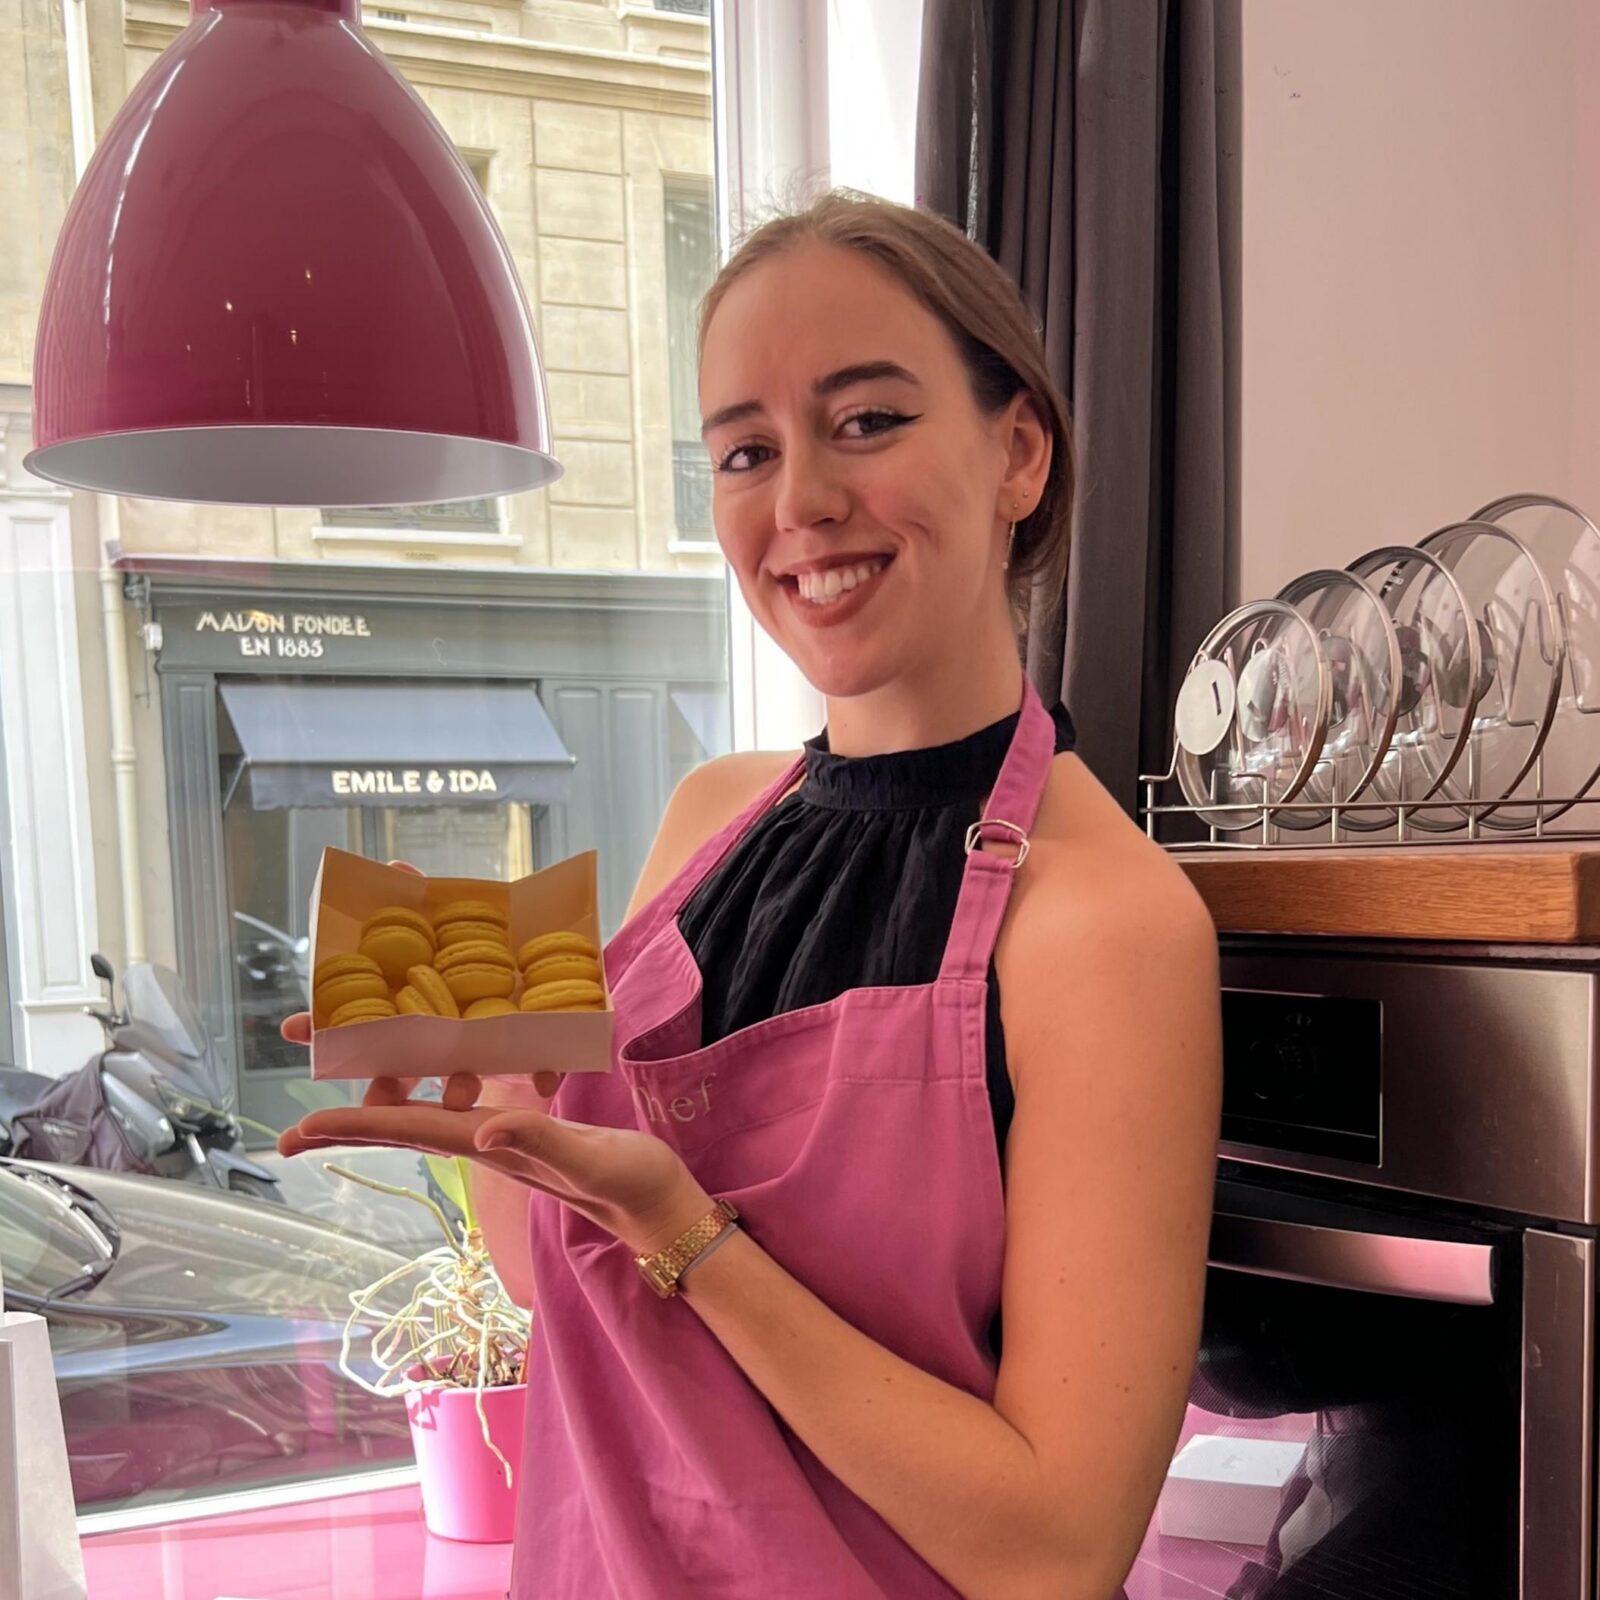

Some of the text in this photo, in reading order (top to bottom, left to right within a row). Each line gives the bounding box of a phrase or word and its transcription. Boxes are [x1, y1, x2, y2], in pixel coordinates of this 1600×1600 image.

[240, 636, 271, 656] EN
[331, 769, 497, 793] EMILE & IDA
[636, 1071, 718, 1123] hef
